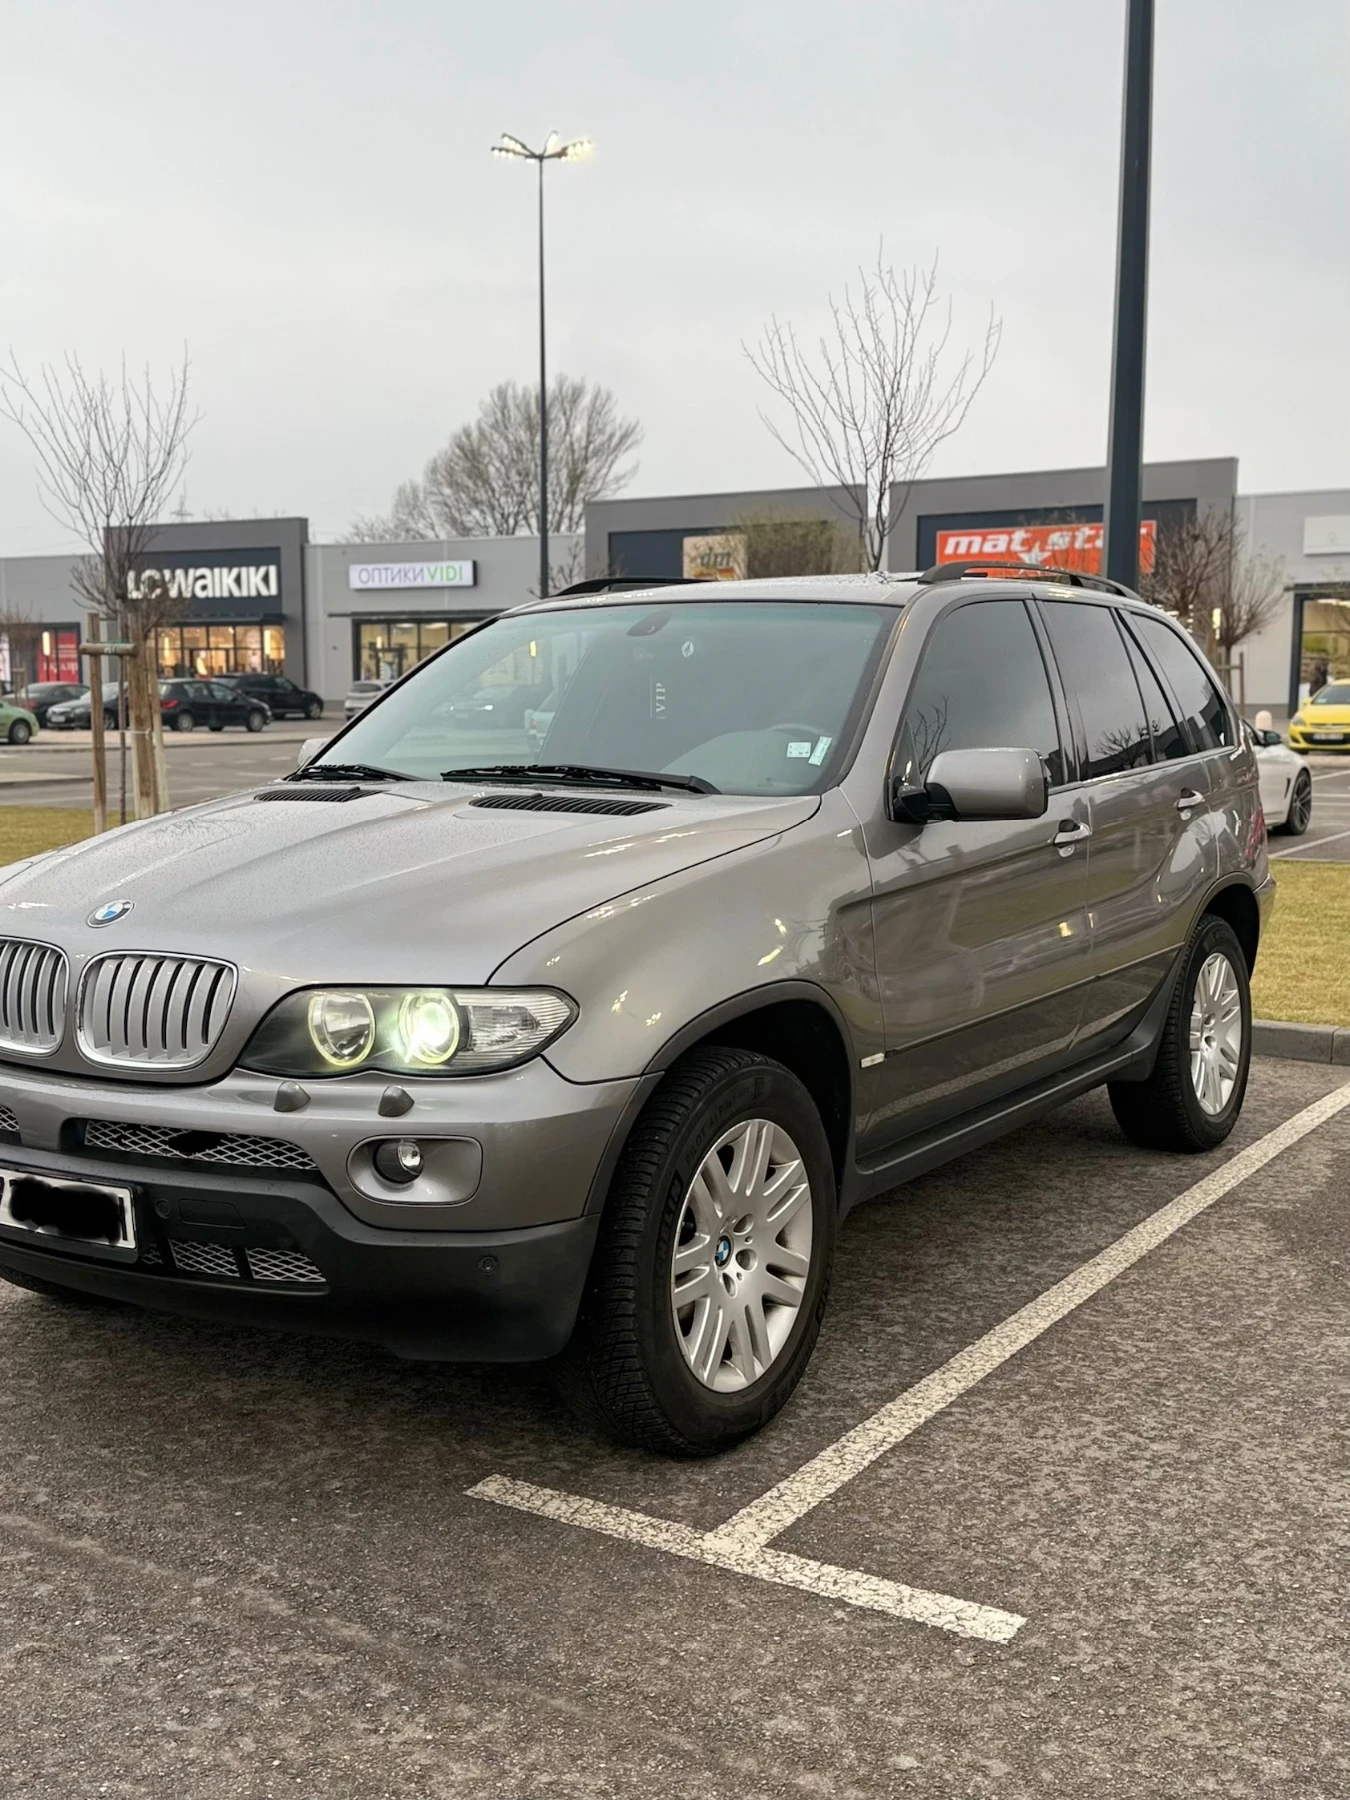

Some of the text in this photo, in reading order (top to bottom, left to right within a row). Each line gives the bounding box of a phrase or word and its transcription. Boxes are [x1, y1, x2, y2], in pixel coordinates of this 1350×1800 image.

[944, 527, 1148, 555] mat st
[655, 682, 666, 713] VIP
